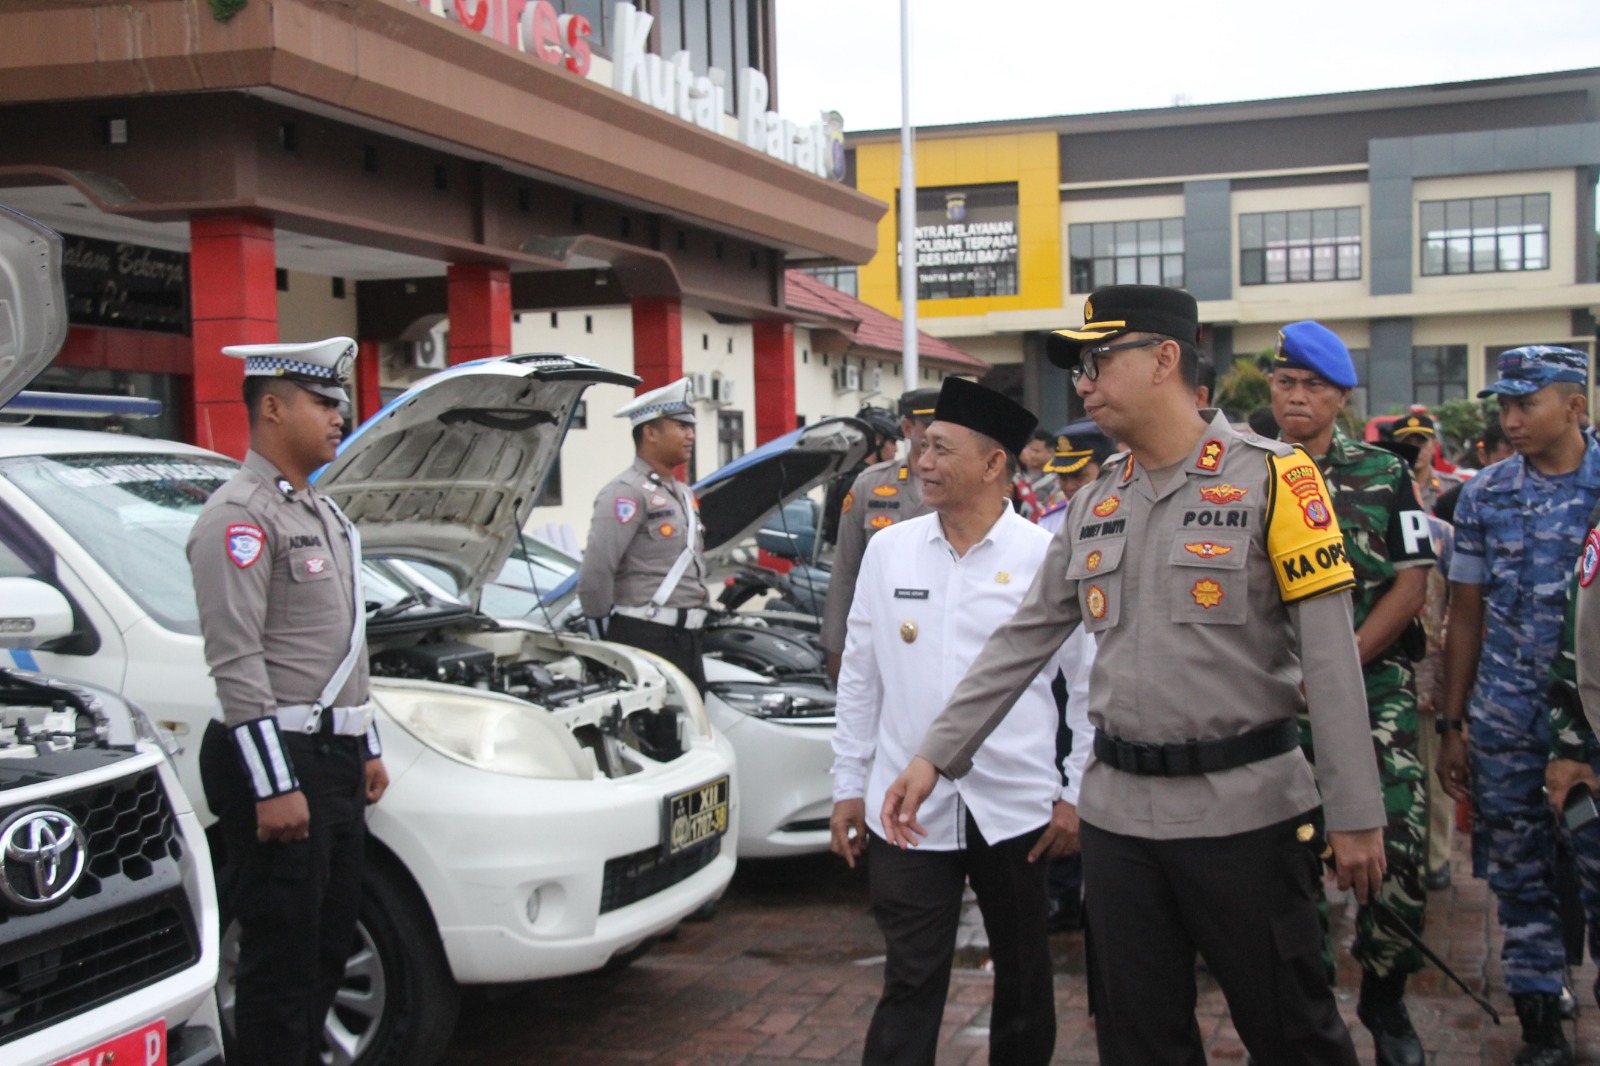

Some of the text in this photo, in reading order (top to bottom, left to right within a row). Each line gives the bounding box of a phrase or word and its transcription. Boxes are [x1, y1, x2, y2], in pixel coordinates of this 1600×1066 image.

[612, 2, 725, 136] Kutai
[738, 66, 828, 179] Barat
[914, 222, 1013, 239] NTRA PELAYANAN
[965, 235, 1017, 250] TERPADU
[943, 251, 976, 265] KUTAI
[1183, 510, 1248, 528] POLRI
[1282, 554, 1315, 583] KA
